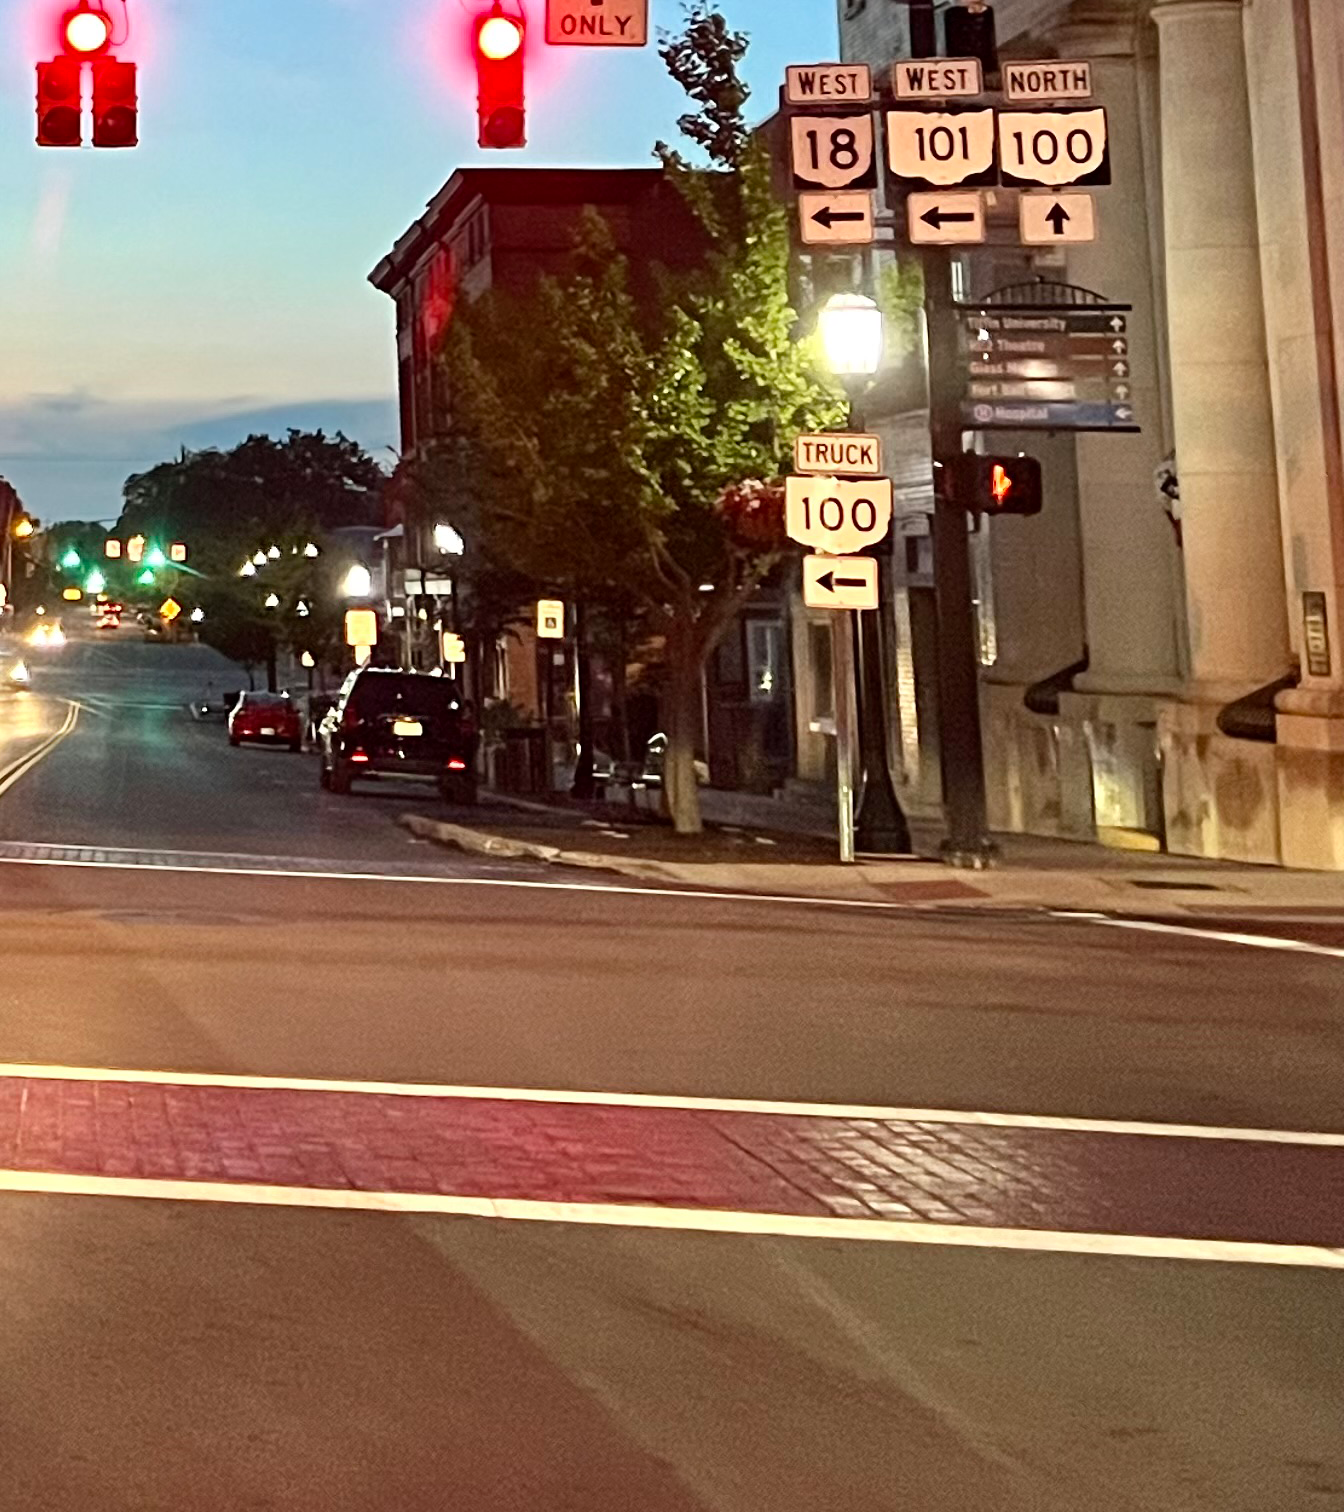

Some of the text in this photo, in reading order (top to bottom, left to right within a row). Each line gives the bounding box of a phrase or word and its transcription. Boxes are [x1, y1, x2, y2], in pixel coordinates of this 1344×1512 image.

[560, 14, 633, 37] ONLY
[798, 72, 859, 96] WEST
[906, 67, 969, 92] WEST
[1010, 67, 1087, 93] NORTH
[805, 128, 860, 170] 18
[914, 125, 970, 162] 101
[1012, 128, 1093, 165] 100
[802, 442, 874, 465] TRUCK
[801, 497, 877, 532] 100
